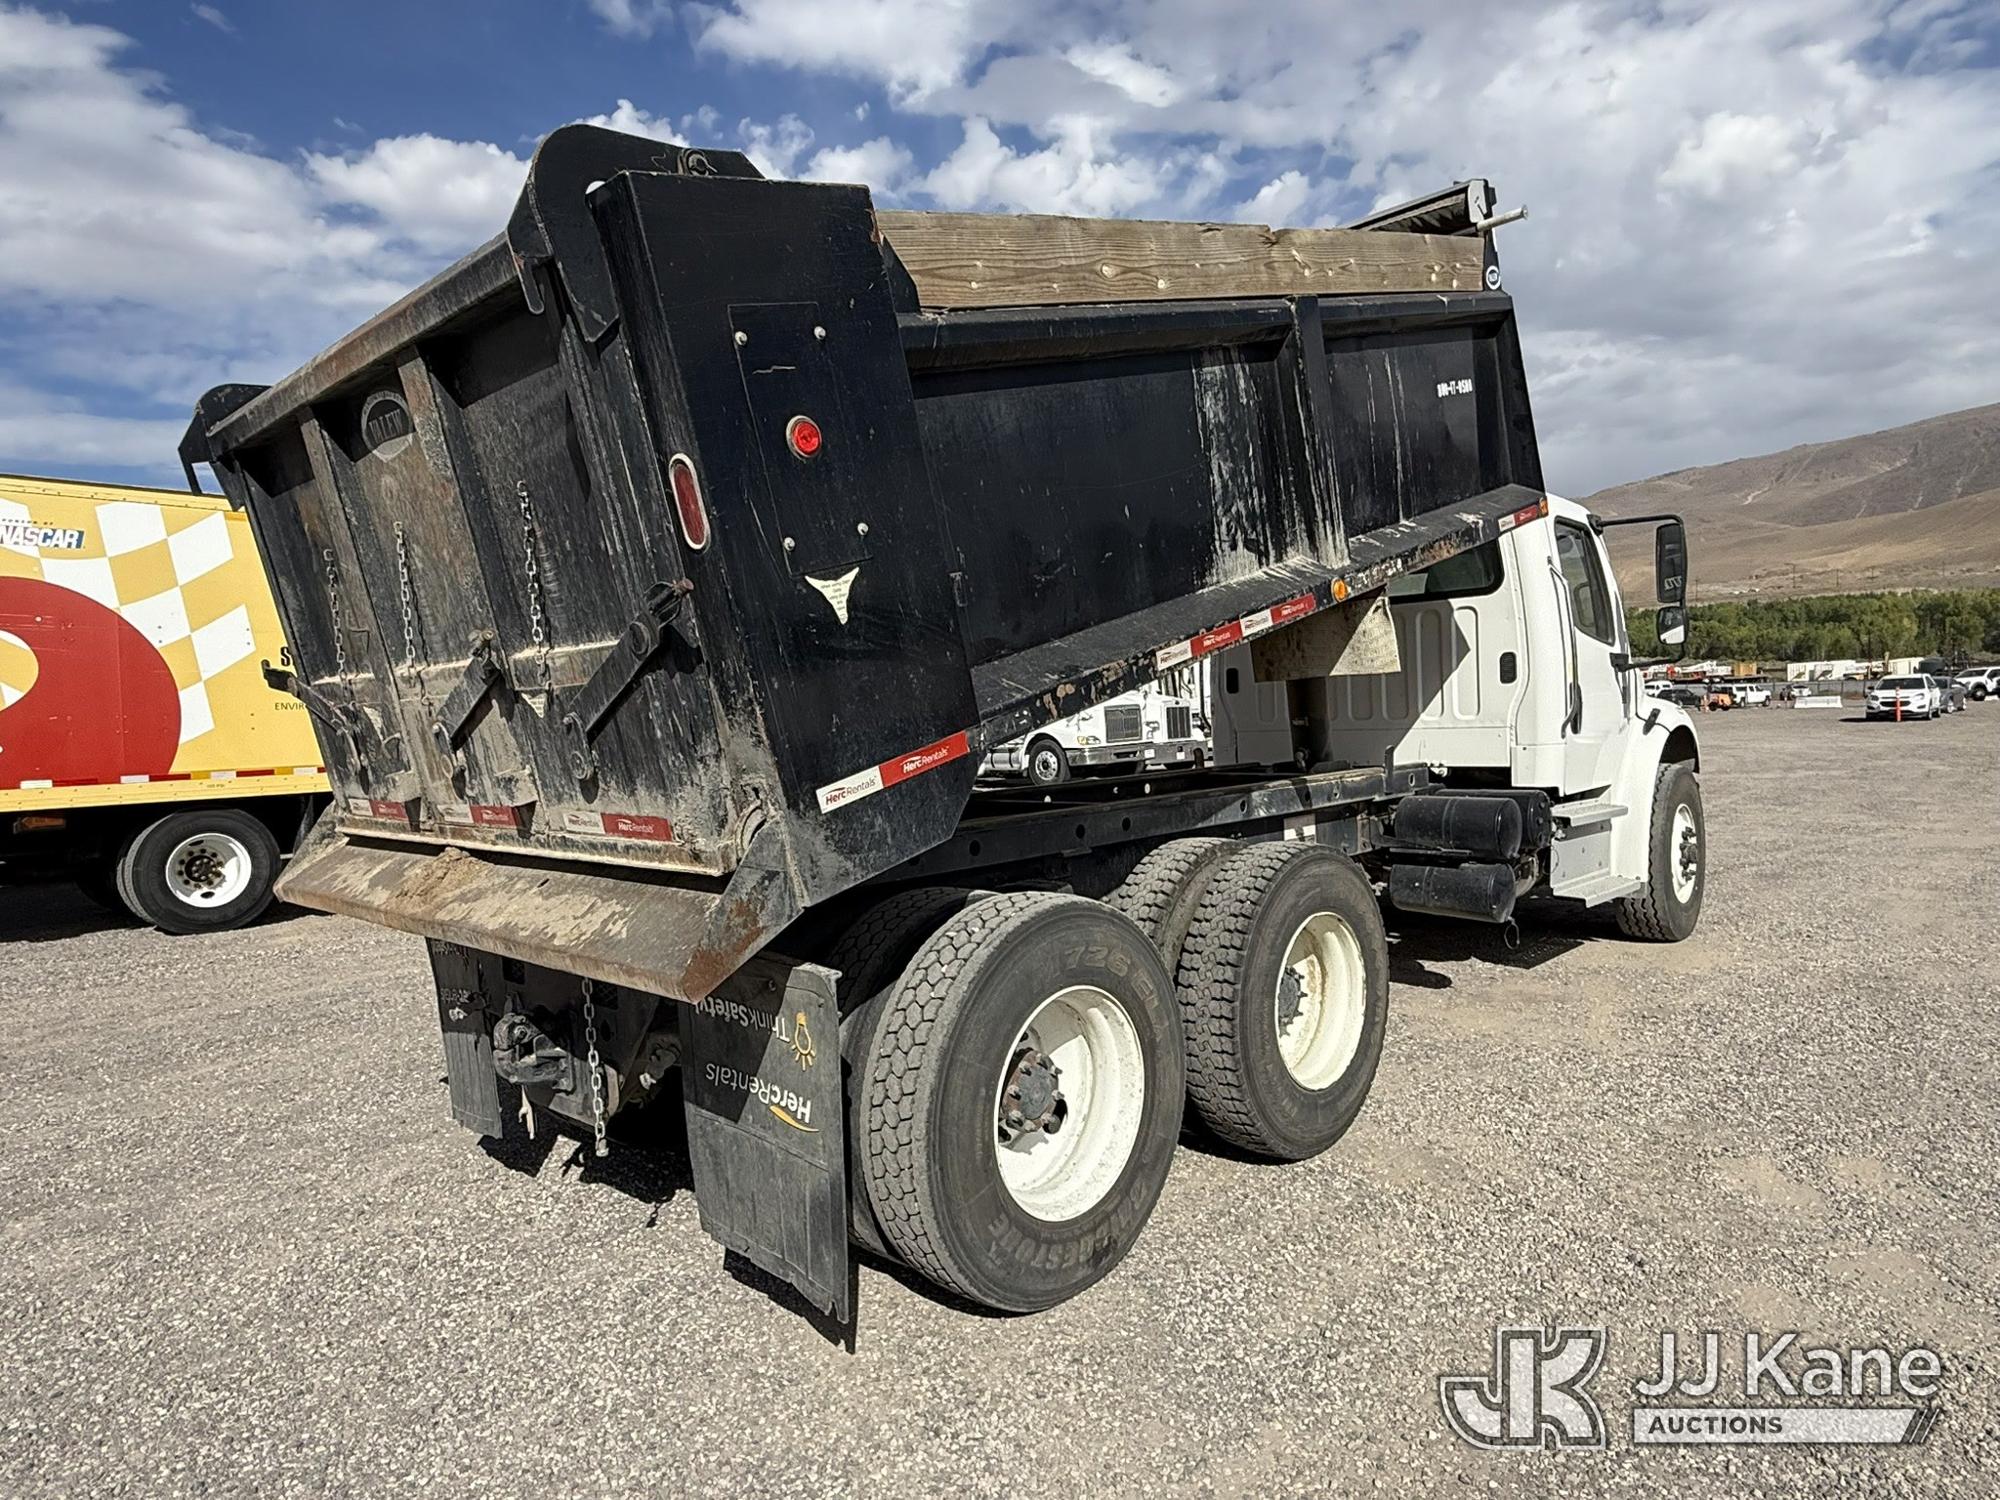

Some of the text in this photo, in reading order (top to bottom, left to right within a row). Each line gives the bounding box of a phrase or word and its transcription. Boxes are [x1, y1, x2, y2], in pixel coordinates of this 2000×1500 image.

[0, 525, 80, 549] NASCAR
[903, 747, 949, 774] HercRentals
[825, 776, 877, 805] HercRentals
[705, 1062, 812, 1123] HercRentals
